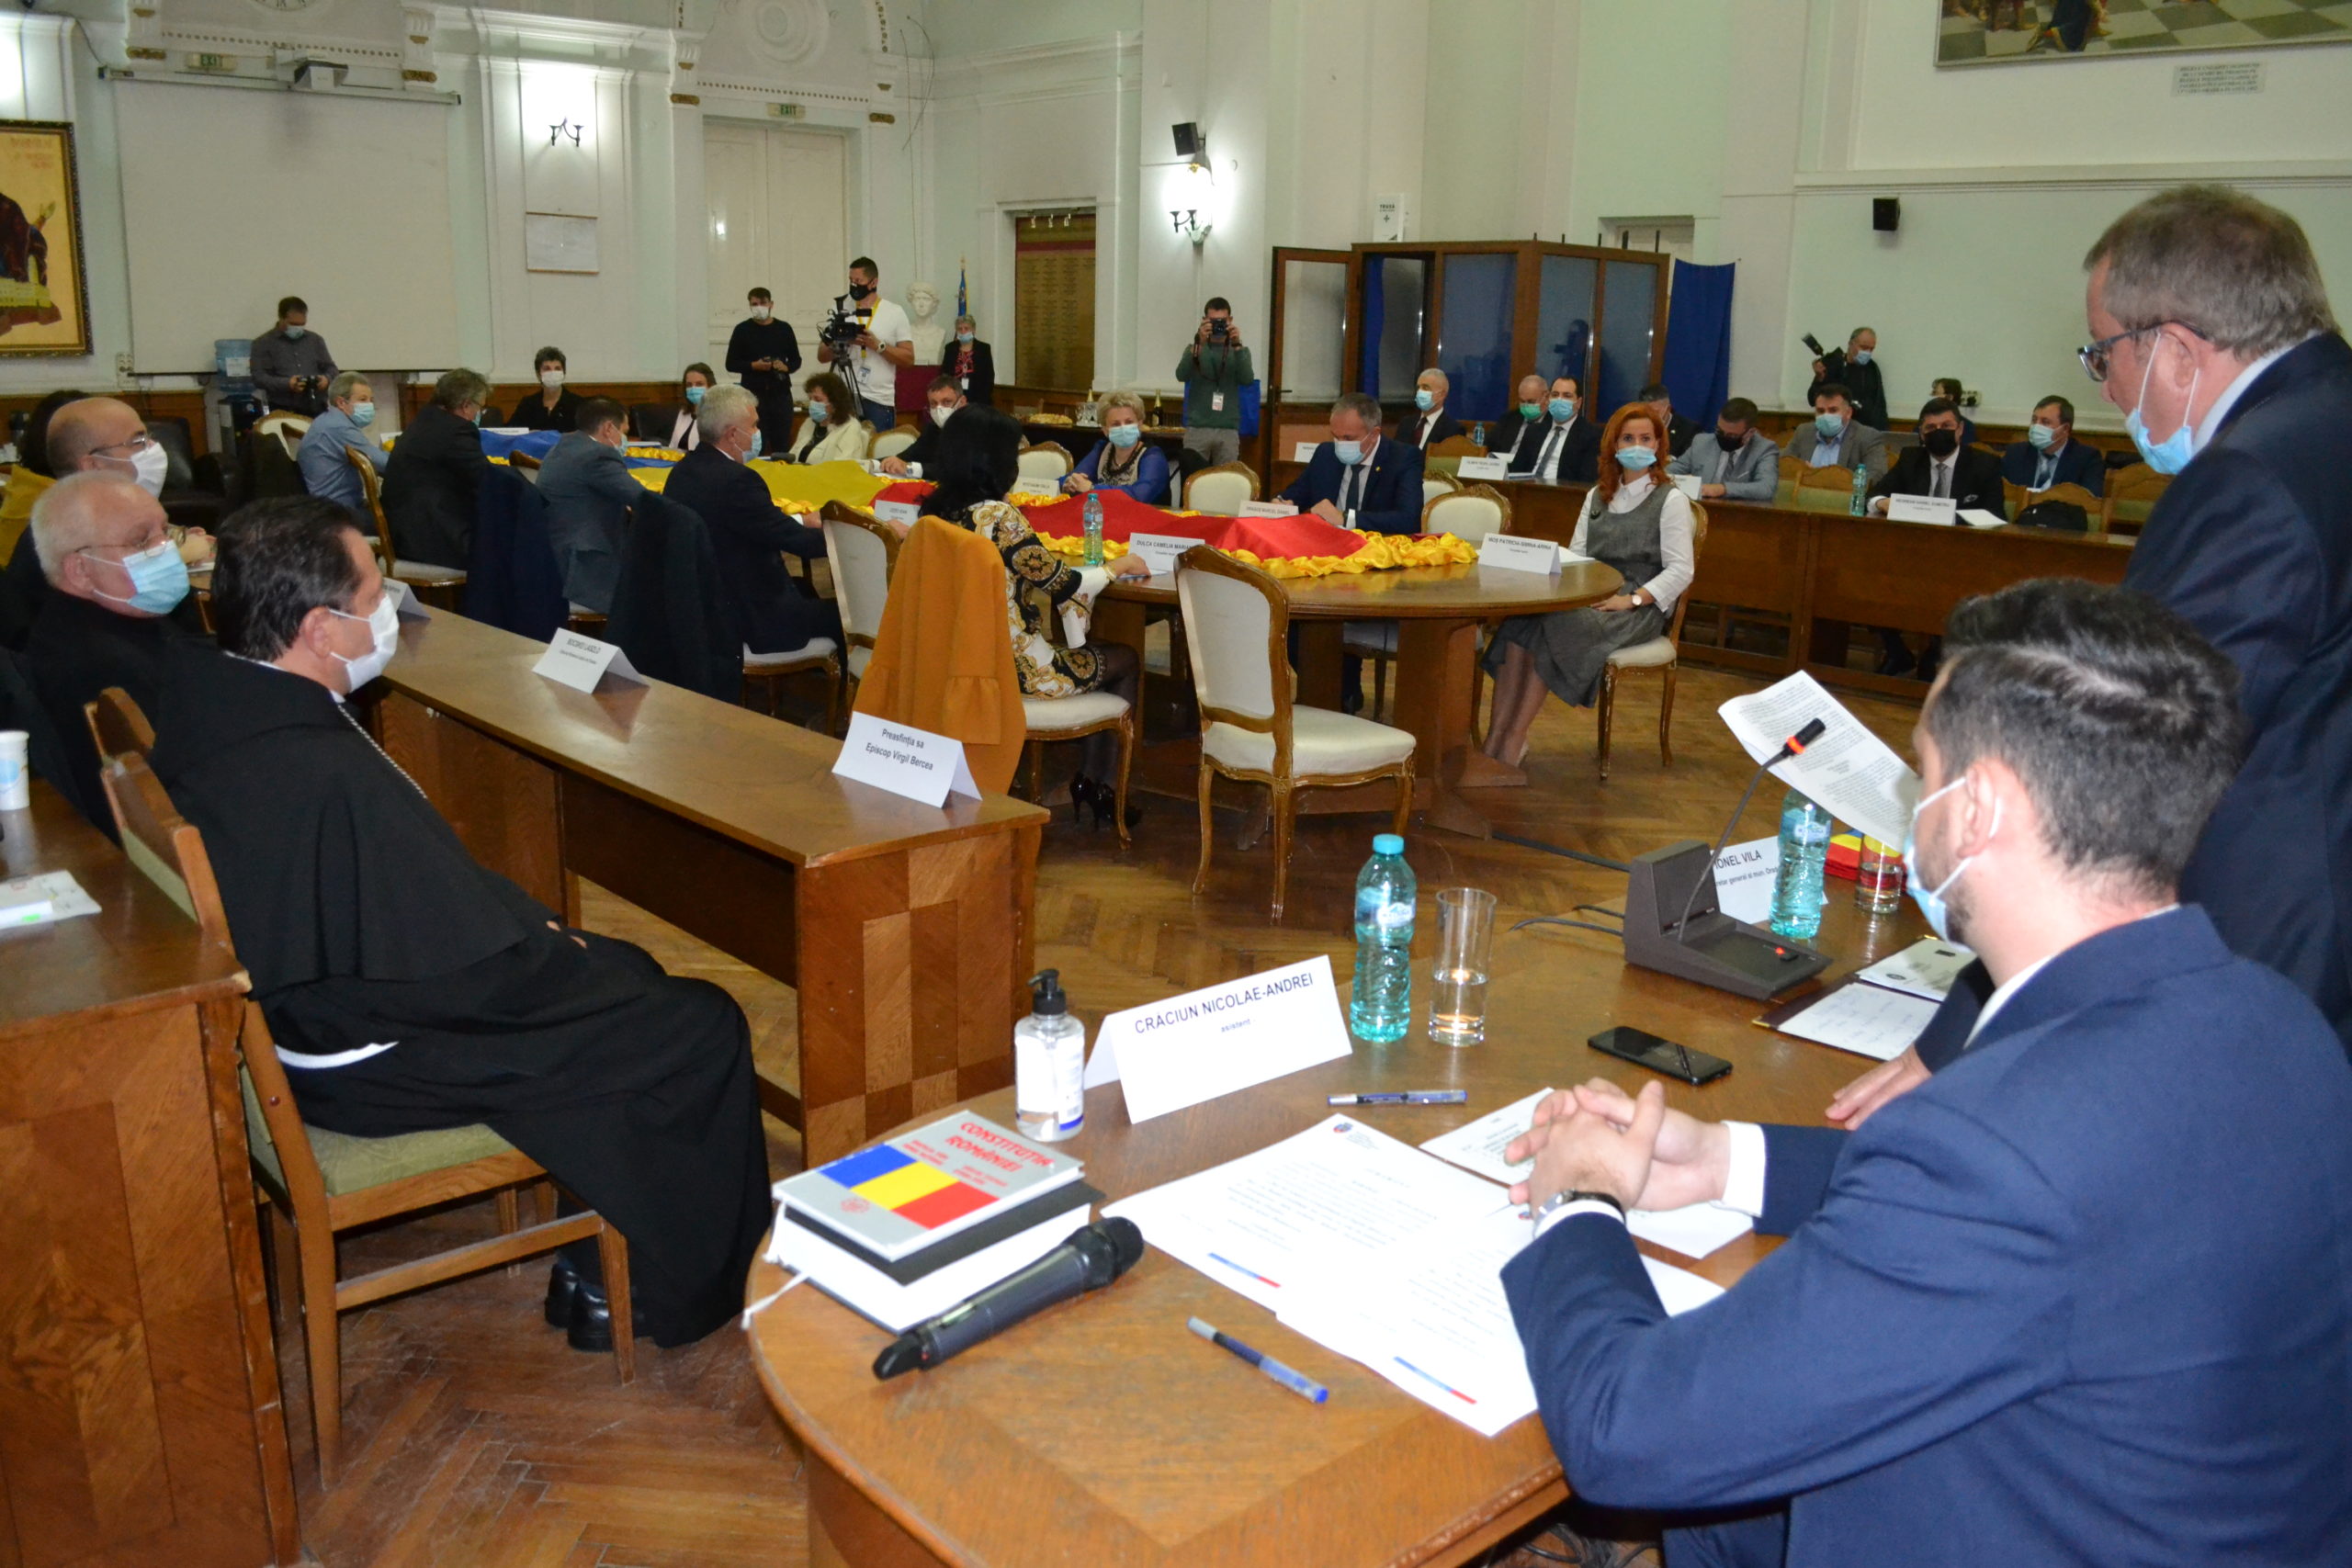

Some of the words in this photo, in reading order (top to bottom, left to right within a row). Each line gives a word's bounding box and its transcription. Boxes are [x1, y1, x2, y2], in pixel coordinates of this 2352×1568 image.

[916, 740, 924, 749] sa
[865, 742, 892, 758] Episcop
[893, 750, 910, 764] Virgil
[910, 755, 933, 771] Bercea
[1714, 855, 1742, 870] IONEL
[1741, 850, 1762, 863] VILA
[1729, 873, 1747, 886] general
[1202, 972, 1314, 1015] NICOLAE-ANDREI
[1220, 1018, 1251, 1033] asistent
